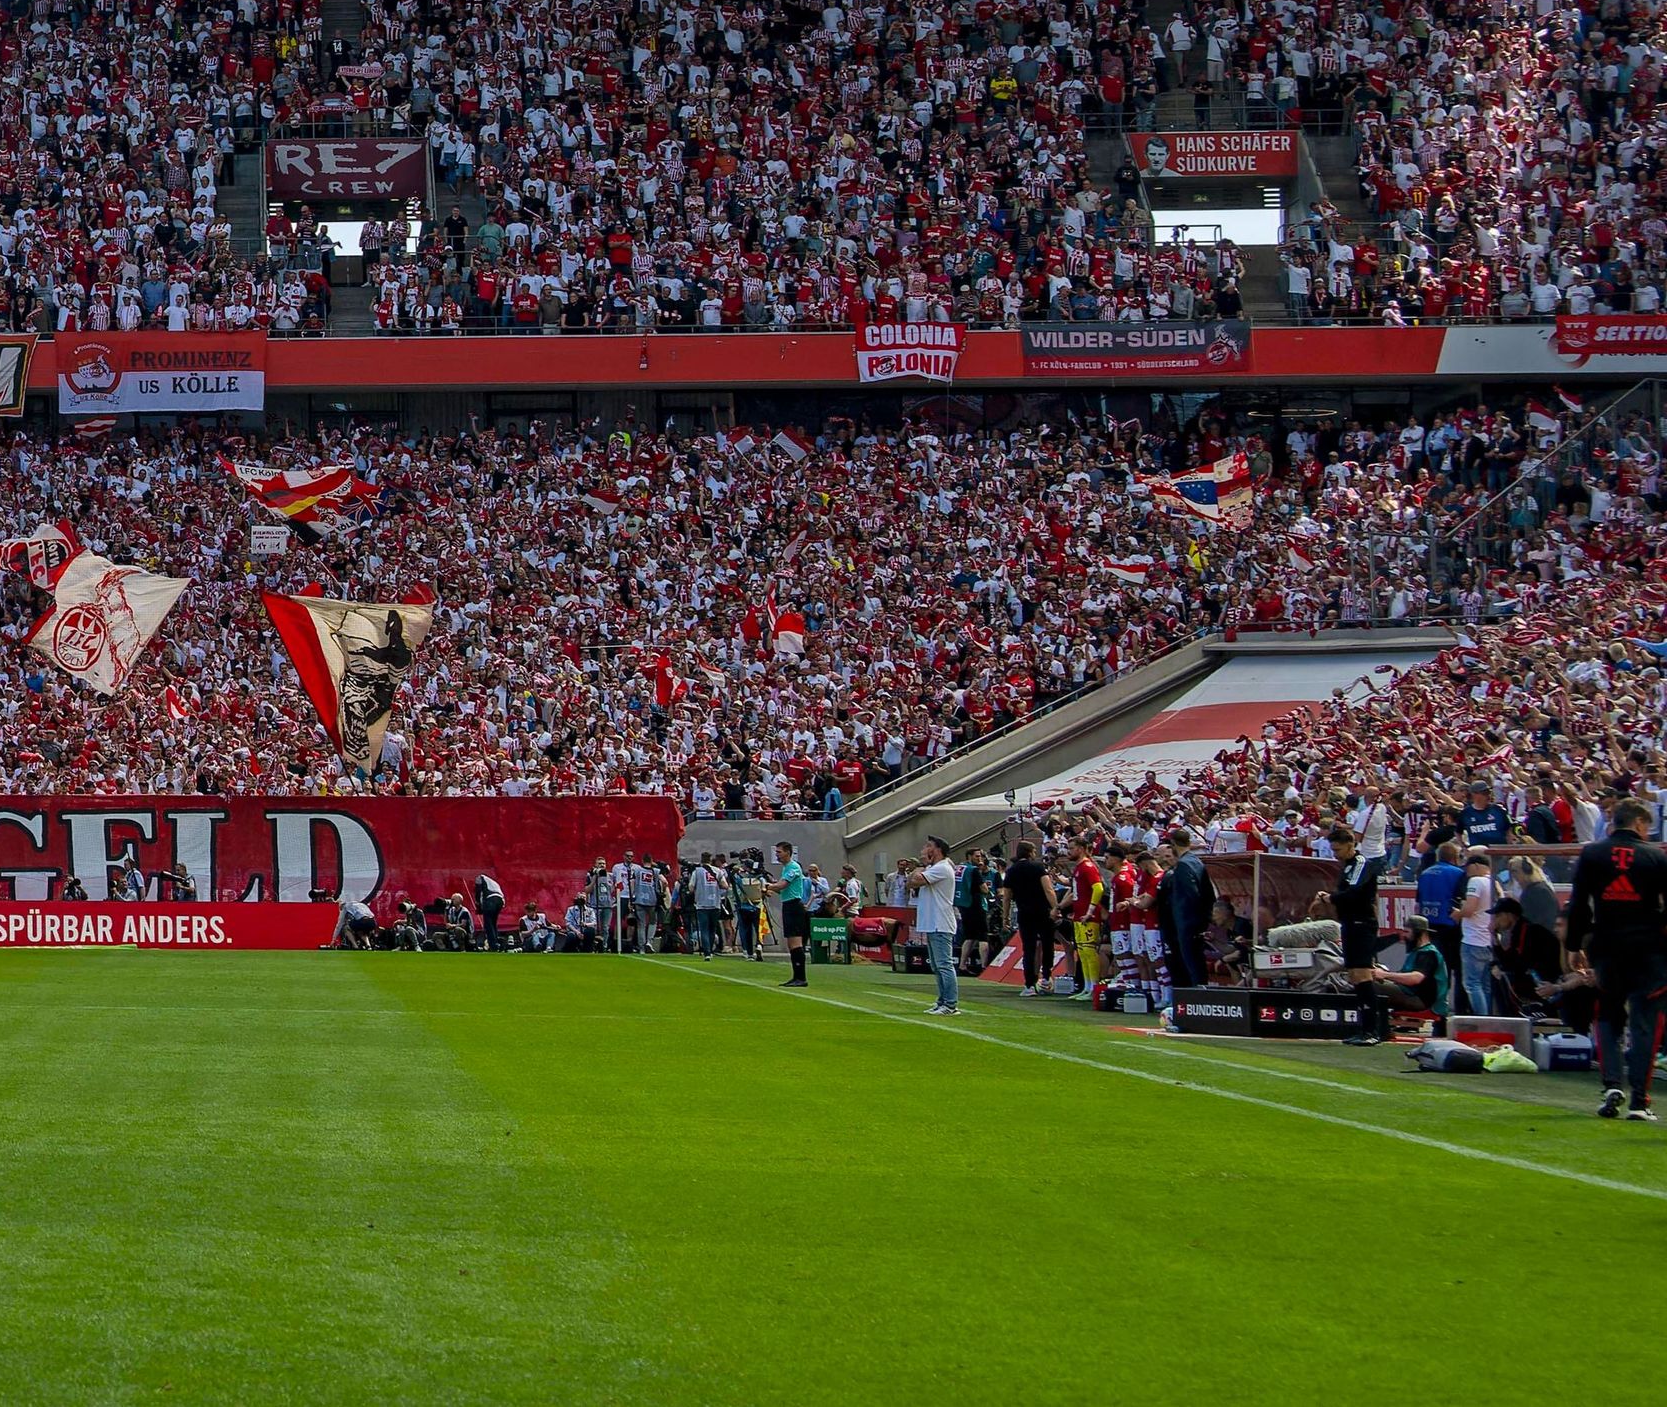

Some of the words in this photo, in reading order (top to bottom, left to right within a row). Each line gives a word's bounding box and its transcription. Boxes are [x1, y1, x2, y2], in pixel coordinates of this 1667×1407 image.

[1176, 137, 1216, 153] HANS
[1221, 133, 1291, 151] SCHÄFER
[1177, 154, 1257, 173] SÜDKURVE
[301, 181, 395, 195] CREW
[865, 324, 957, 346] COLONIA
[1031, 327, 1206, 349] WILDER-SÜDEN
[130, 351, 252, 368] PROMINENZ
[139, 380, 160, 394] US
[172, 372, 240, 394] KÖLLE
[1470, 822, 1498, 835] REWE
[122, 914, 233, 944] ANDERS.
[1186, 1003, 1244, 1019] BUNDESLIGA
